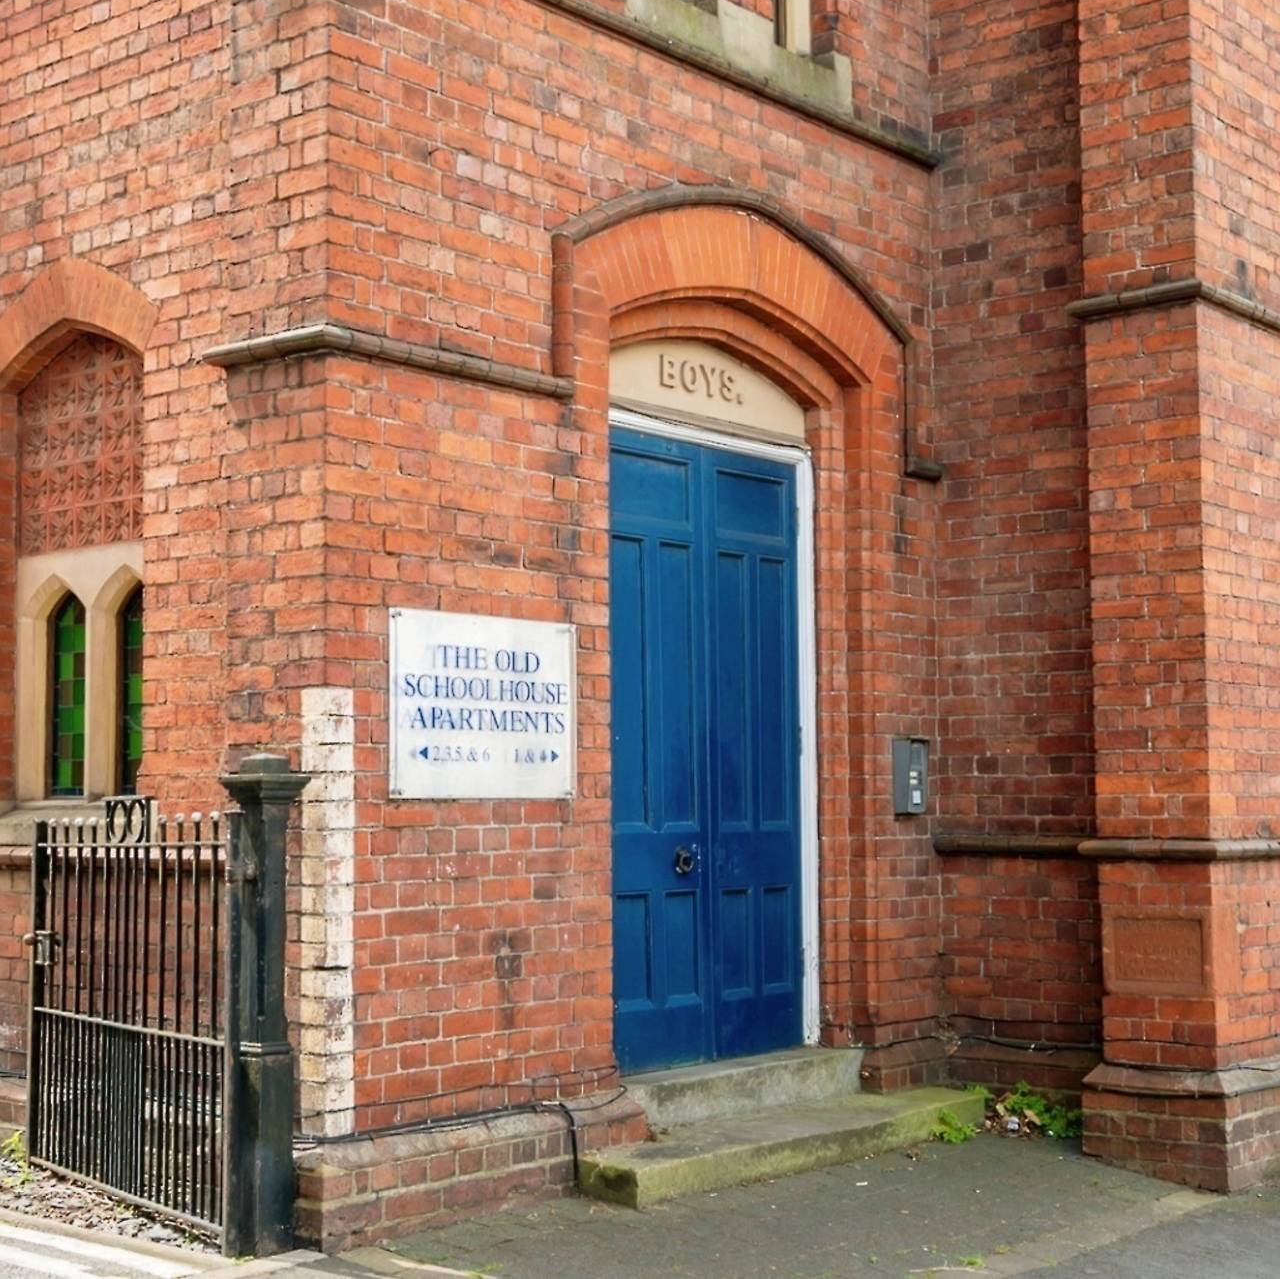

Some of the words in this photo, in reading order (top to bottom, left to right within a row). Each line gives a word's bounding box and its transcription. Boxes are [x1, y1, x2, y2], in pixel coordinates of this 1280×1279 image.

[437, 644, 488, 670] THE
[494, 649, 540, 673] OLD
[403, 674, 568, 706] SCHOOLHOUSE
[410, 706, 566, 735] APARTMENTS
[466, 746, 479, 762] &
[482, 746, 491, 762] 6
[524, 748, 535, 764] &
